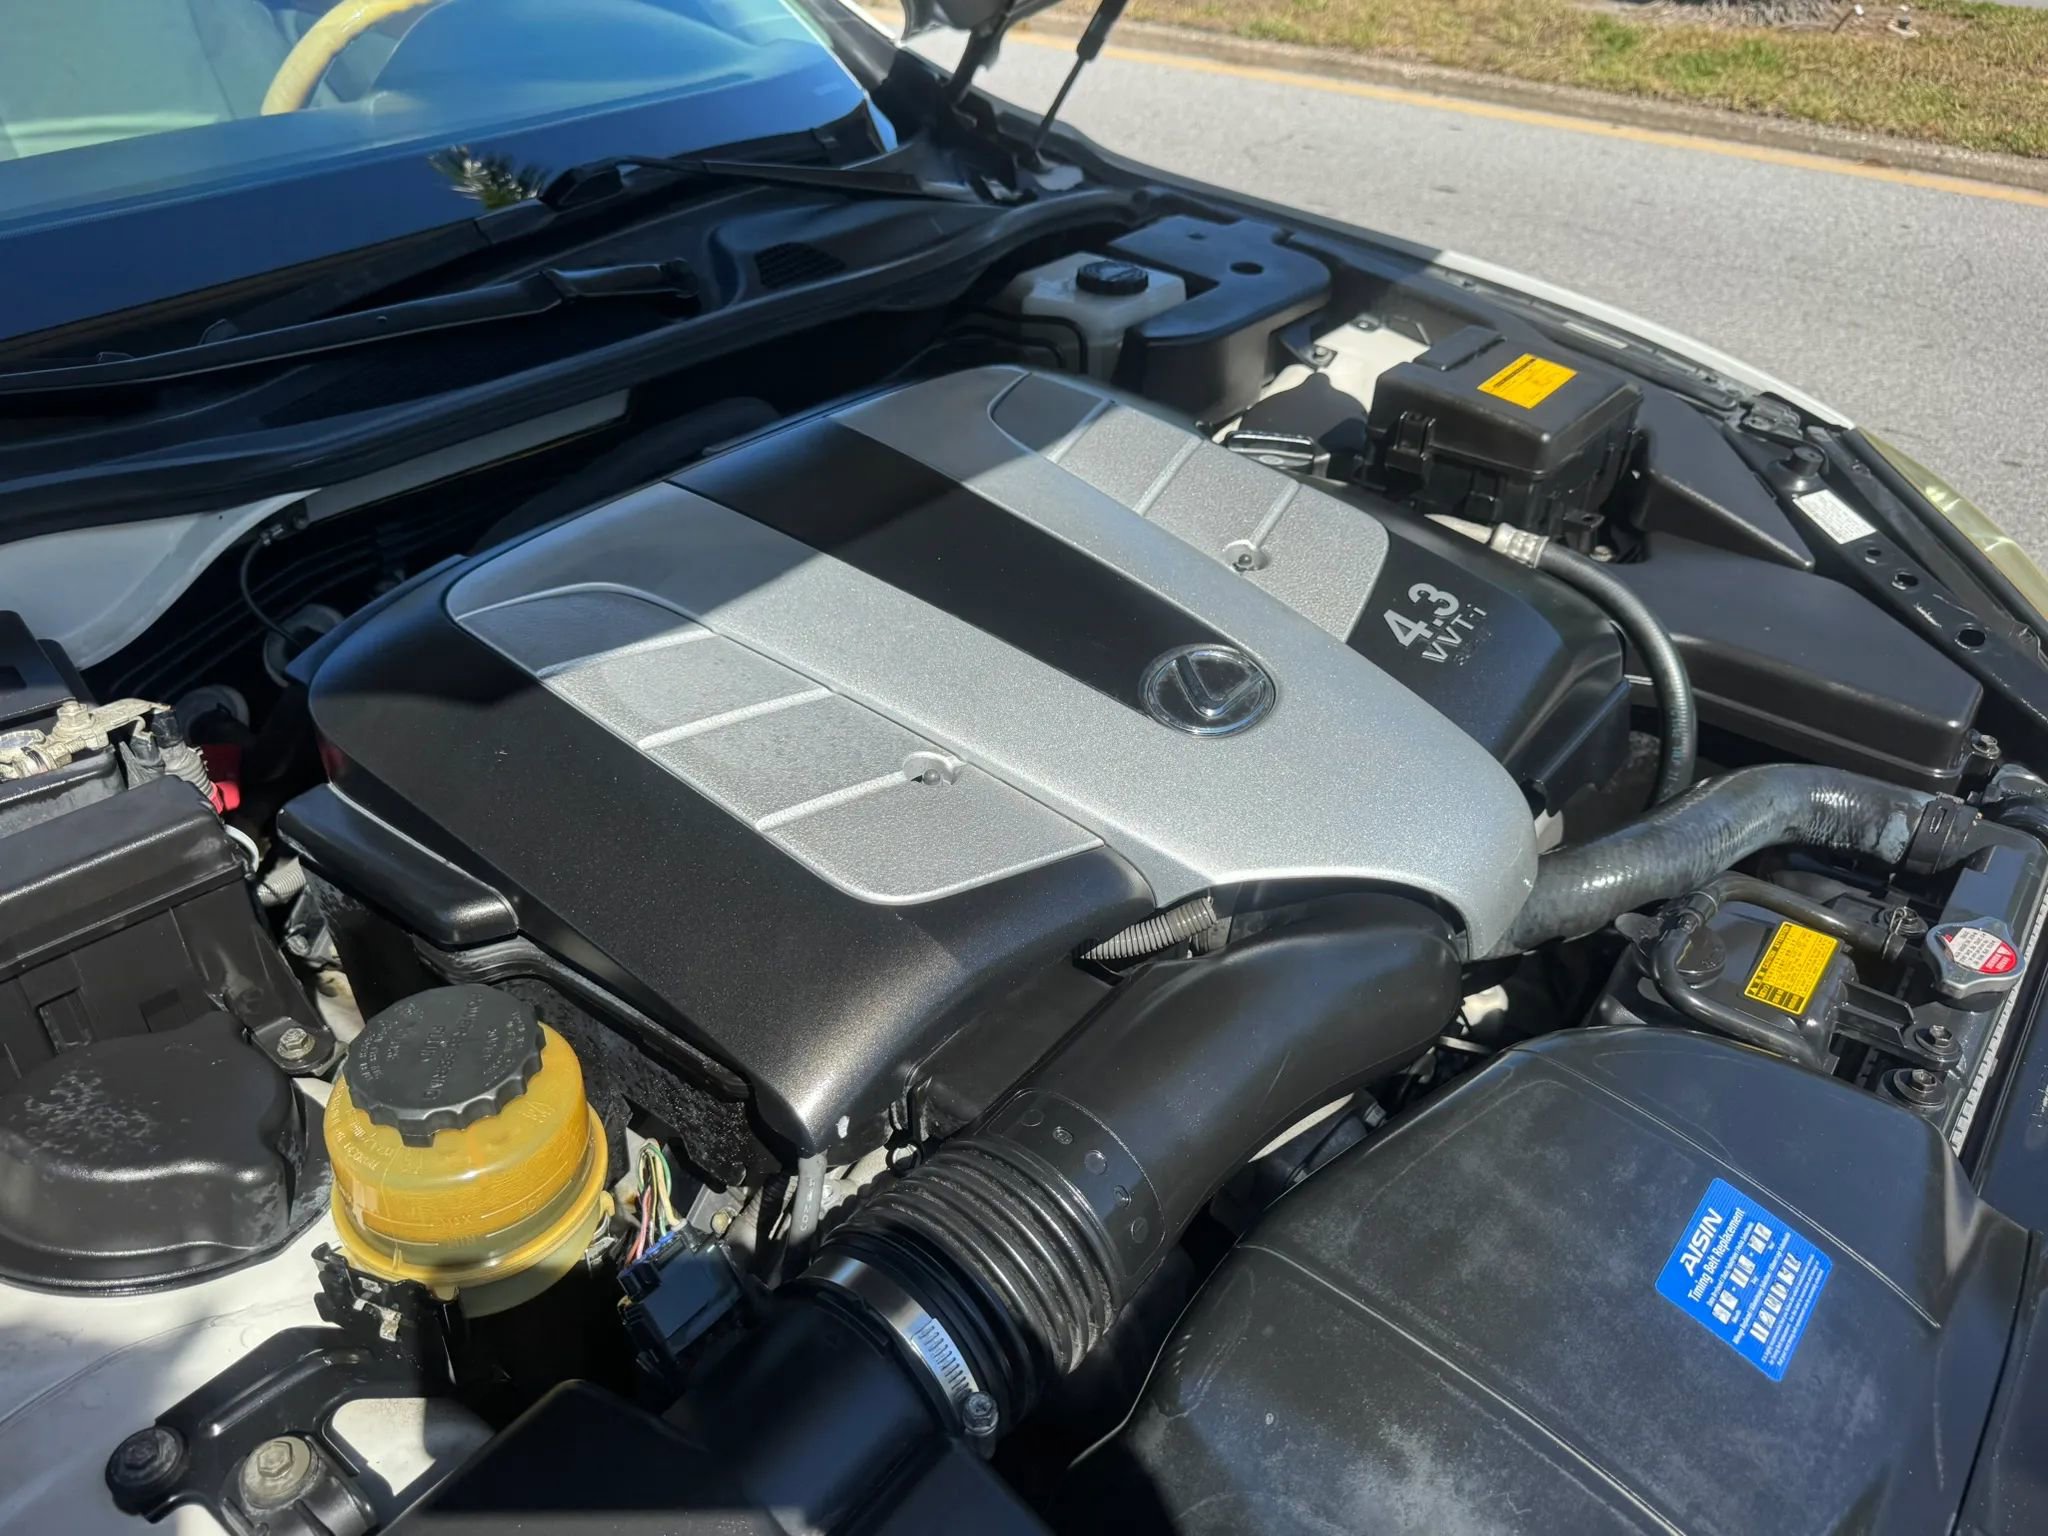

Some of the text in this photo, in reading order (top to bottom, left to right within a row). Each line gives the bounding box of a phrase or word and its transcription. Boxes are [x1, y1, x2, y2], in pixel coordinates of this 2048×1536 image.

[1384, 583, 1459, 647] 4.3
[1422, 603, 1487, 663] VVT-i
[1678, 1207, 1723, 1277] AISIN
[1688, 1269, 1711, 1303] Timing
[1702, 1251, 1721, 1275] Belt
[1712, 1206, 1746, 1259] Replacement
